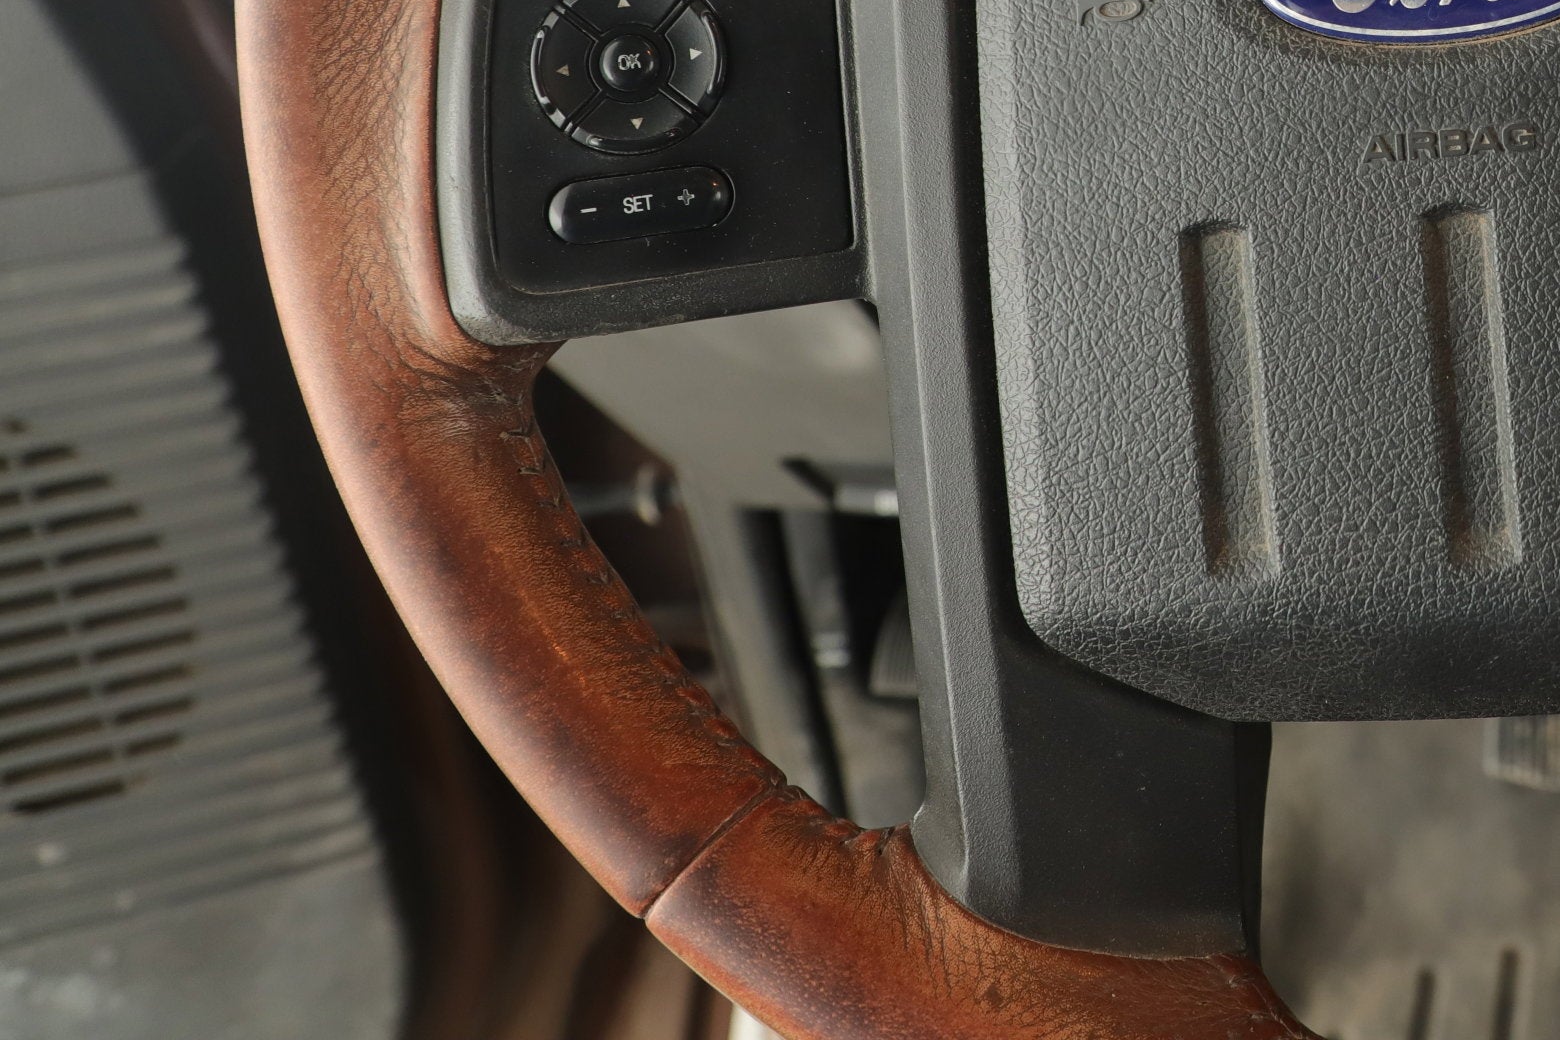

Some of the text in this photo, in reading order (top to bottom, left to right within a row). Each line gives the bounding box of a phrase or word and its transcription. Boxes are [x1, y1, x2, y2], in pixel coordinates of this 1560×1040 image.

[617, 53, 642, 71] OK
[1364, 122, 1537, 163] AIRBAG
[623, 194, 653, 214] SET
